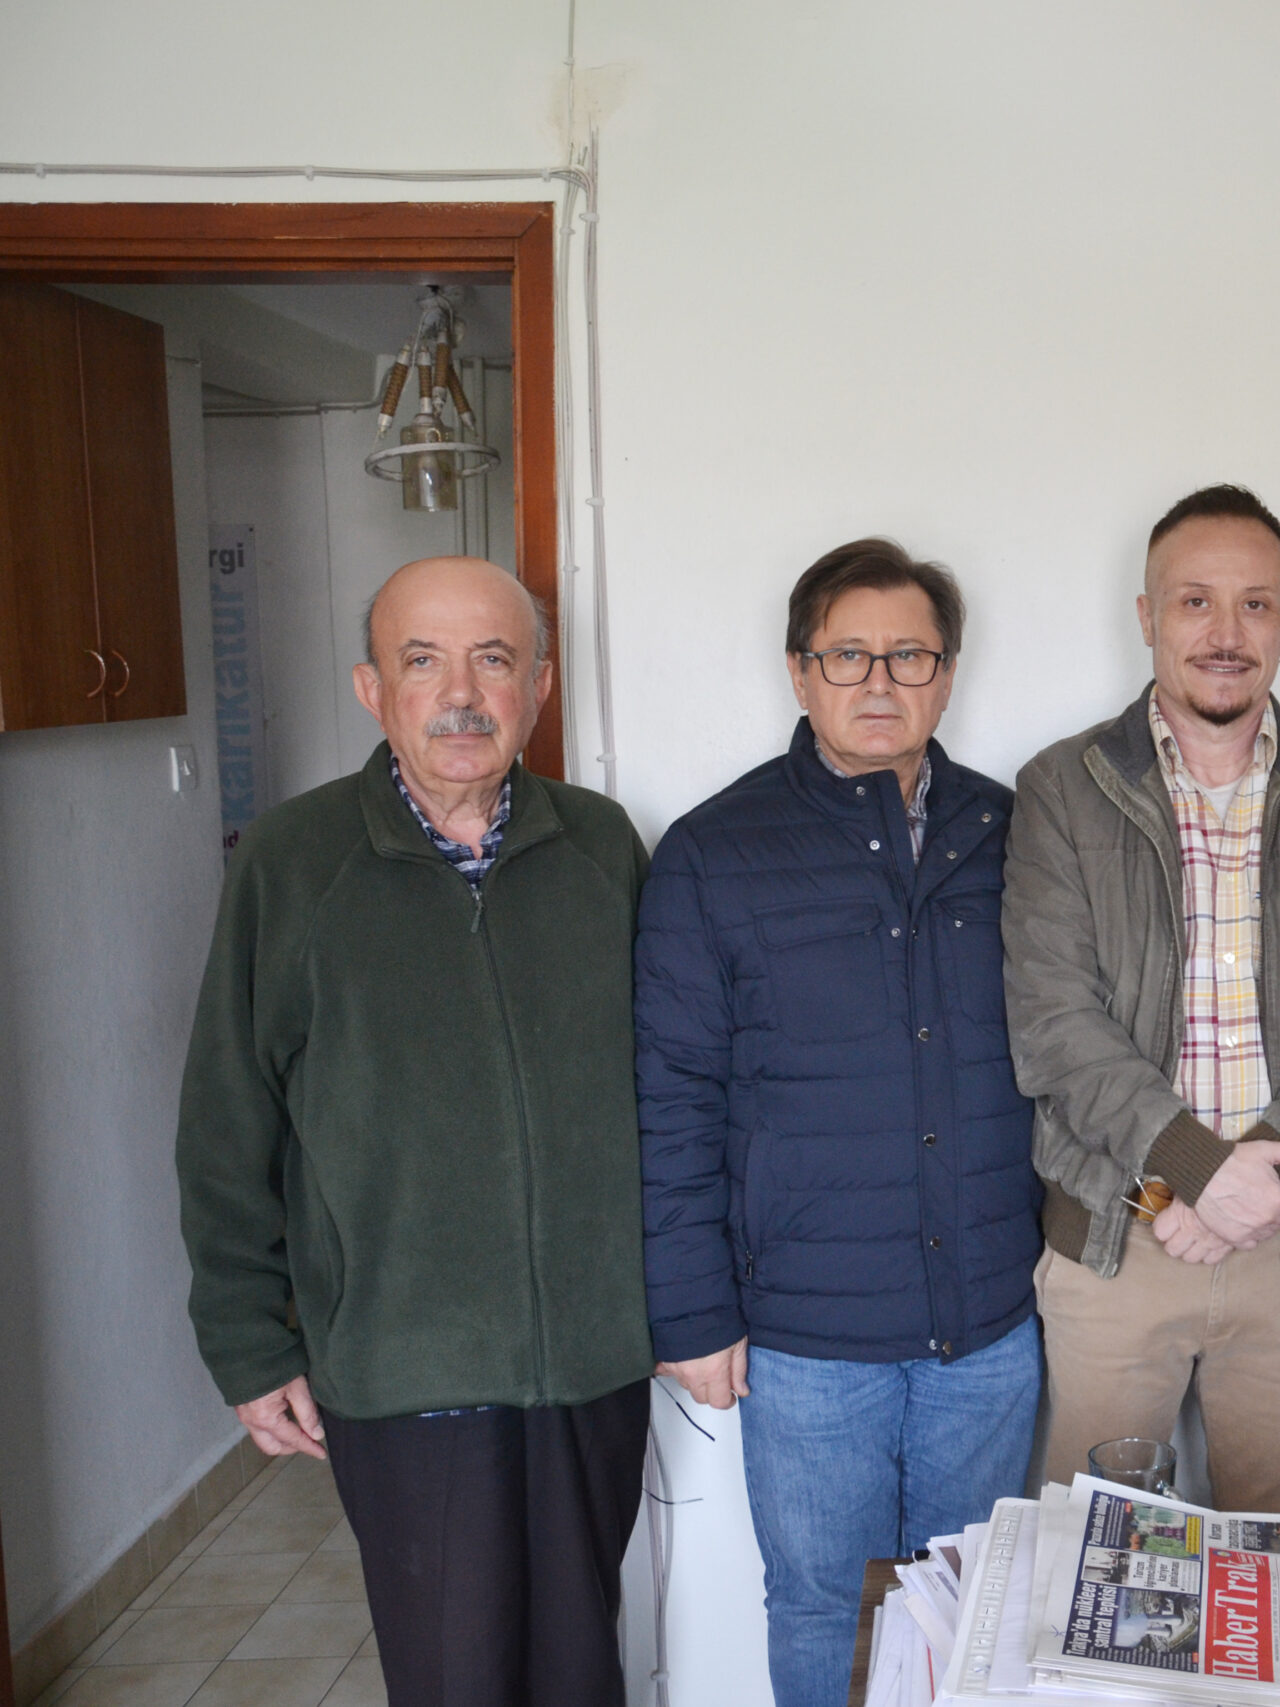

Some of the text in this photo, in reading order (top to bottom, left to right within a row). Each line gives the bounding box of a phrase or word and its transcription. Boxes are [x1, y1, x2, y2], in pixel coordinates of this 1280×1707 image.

[1066, 1582, 1097, 1656] Trakya'da nükleer
[1094, 1585, 1118, 1648] santral tepkisi
[1212, 1560, 1259, 1681] HaberTrak
